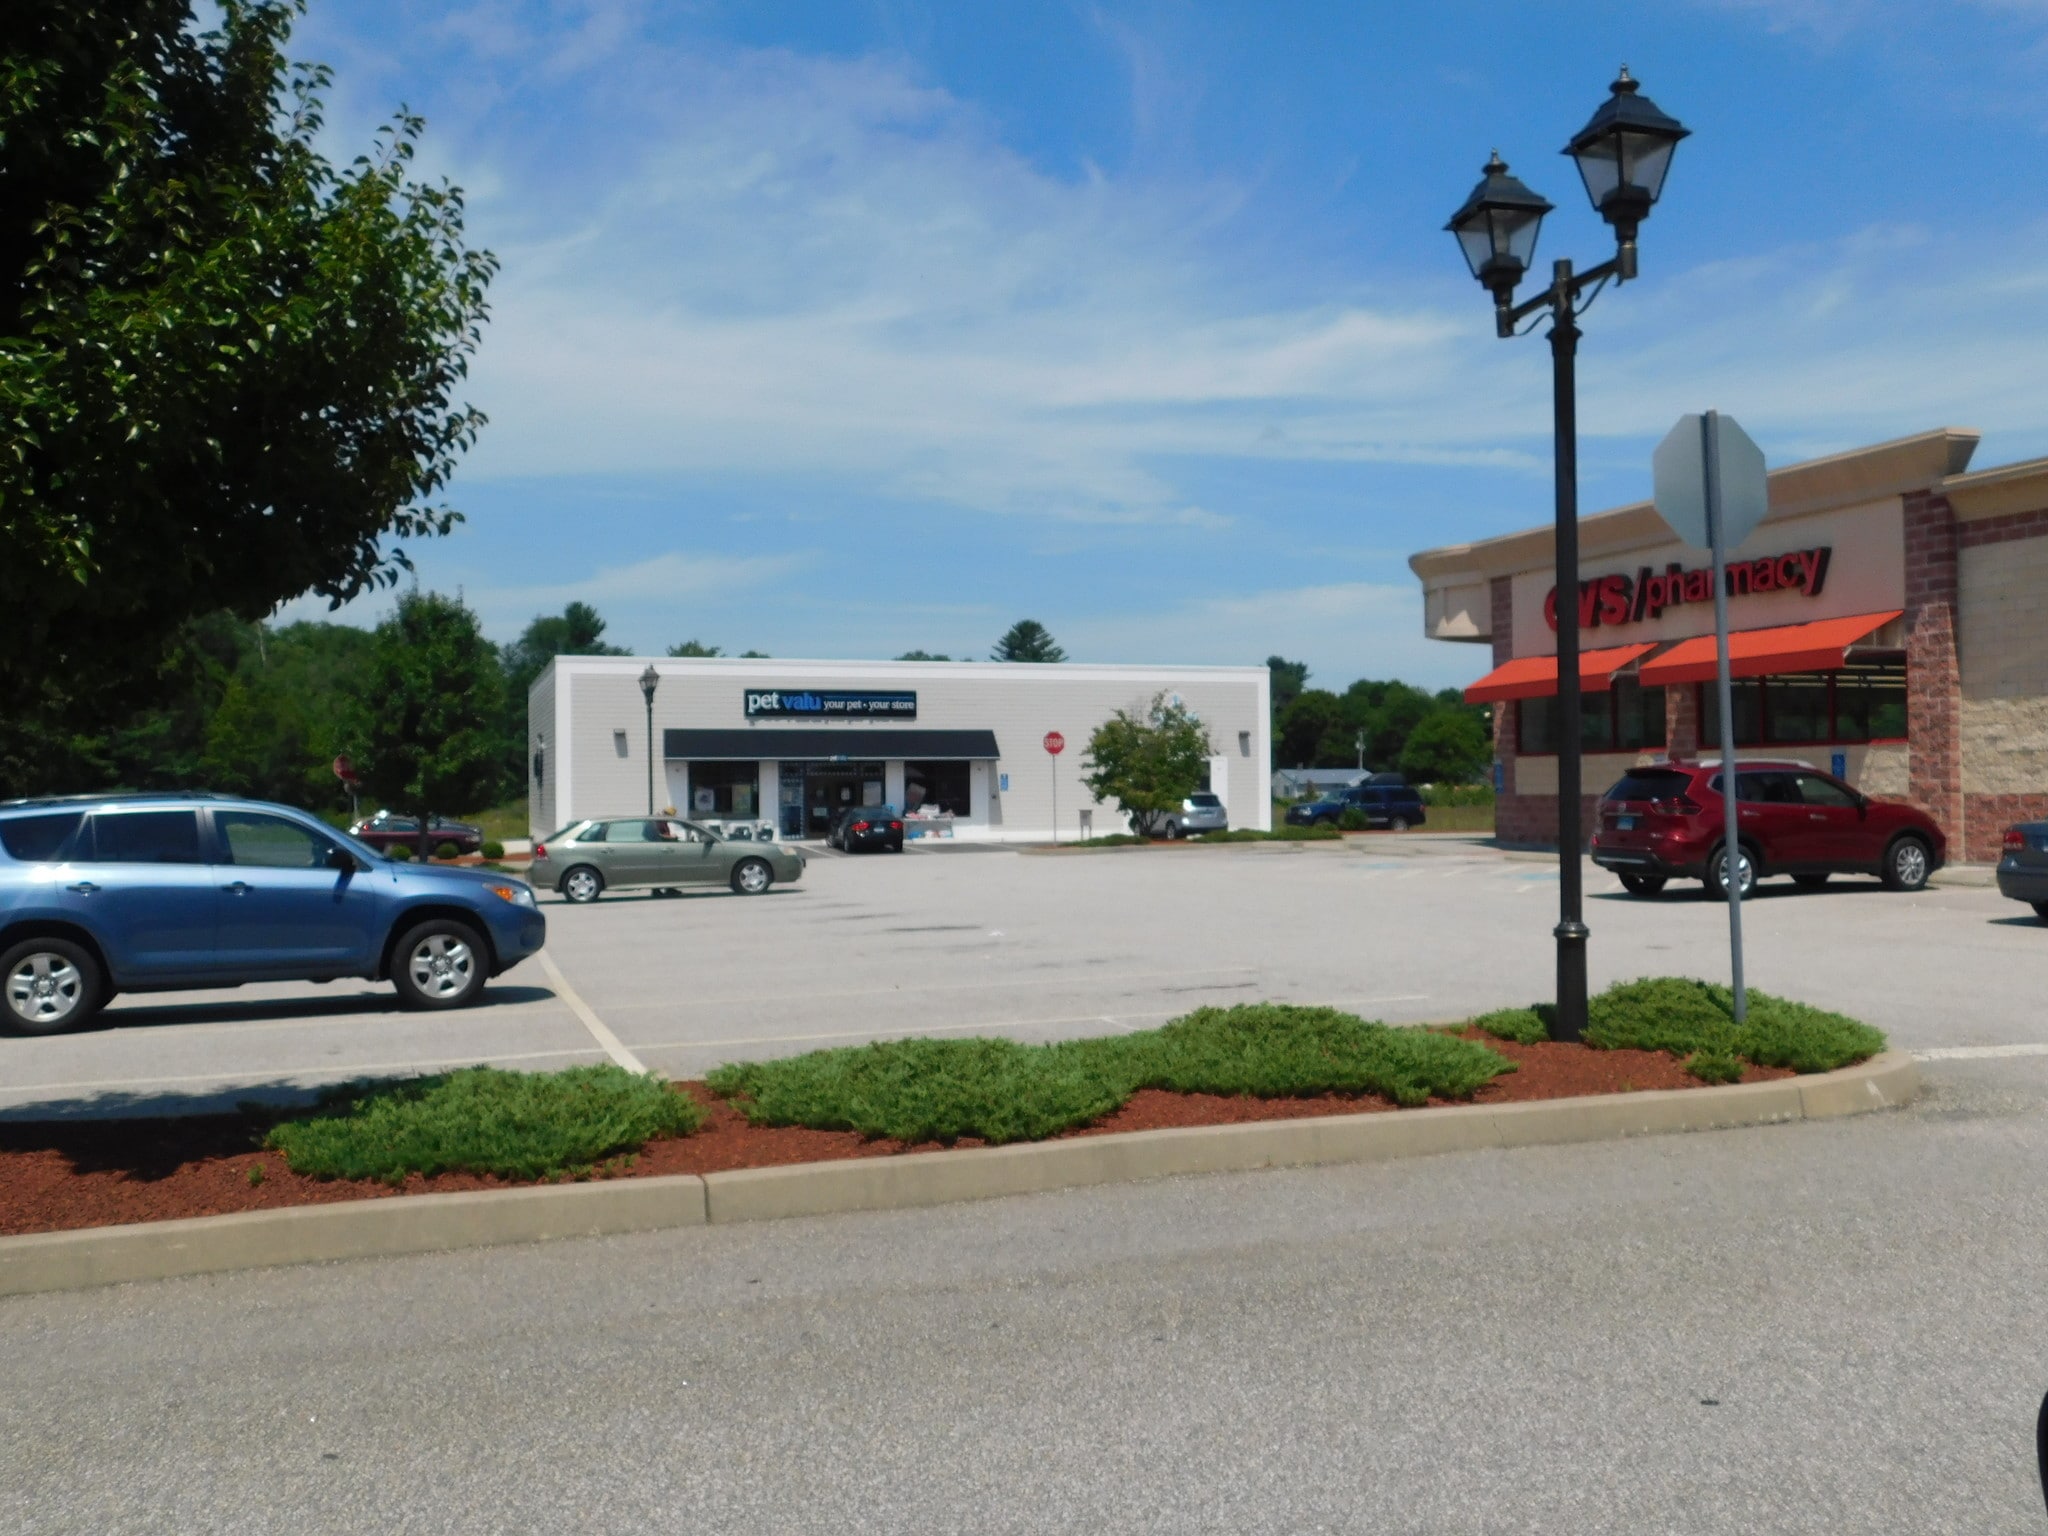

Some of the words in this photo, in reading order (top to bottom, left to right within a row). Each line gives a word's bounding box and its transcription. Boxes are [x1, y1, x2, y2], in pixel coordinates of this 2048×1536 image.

[747, 691, 780, 713] pet
[782, 692, 822, 711] valu
[823, 700, 845, 712] your
[847, 700, 862, 712] pet
[868, 700, 890, 712] your
[891, 700, 914, 710] store
[1044, 738, 1063, 748] STOP
